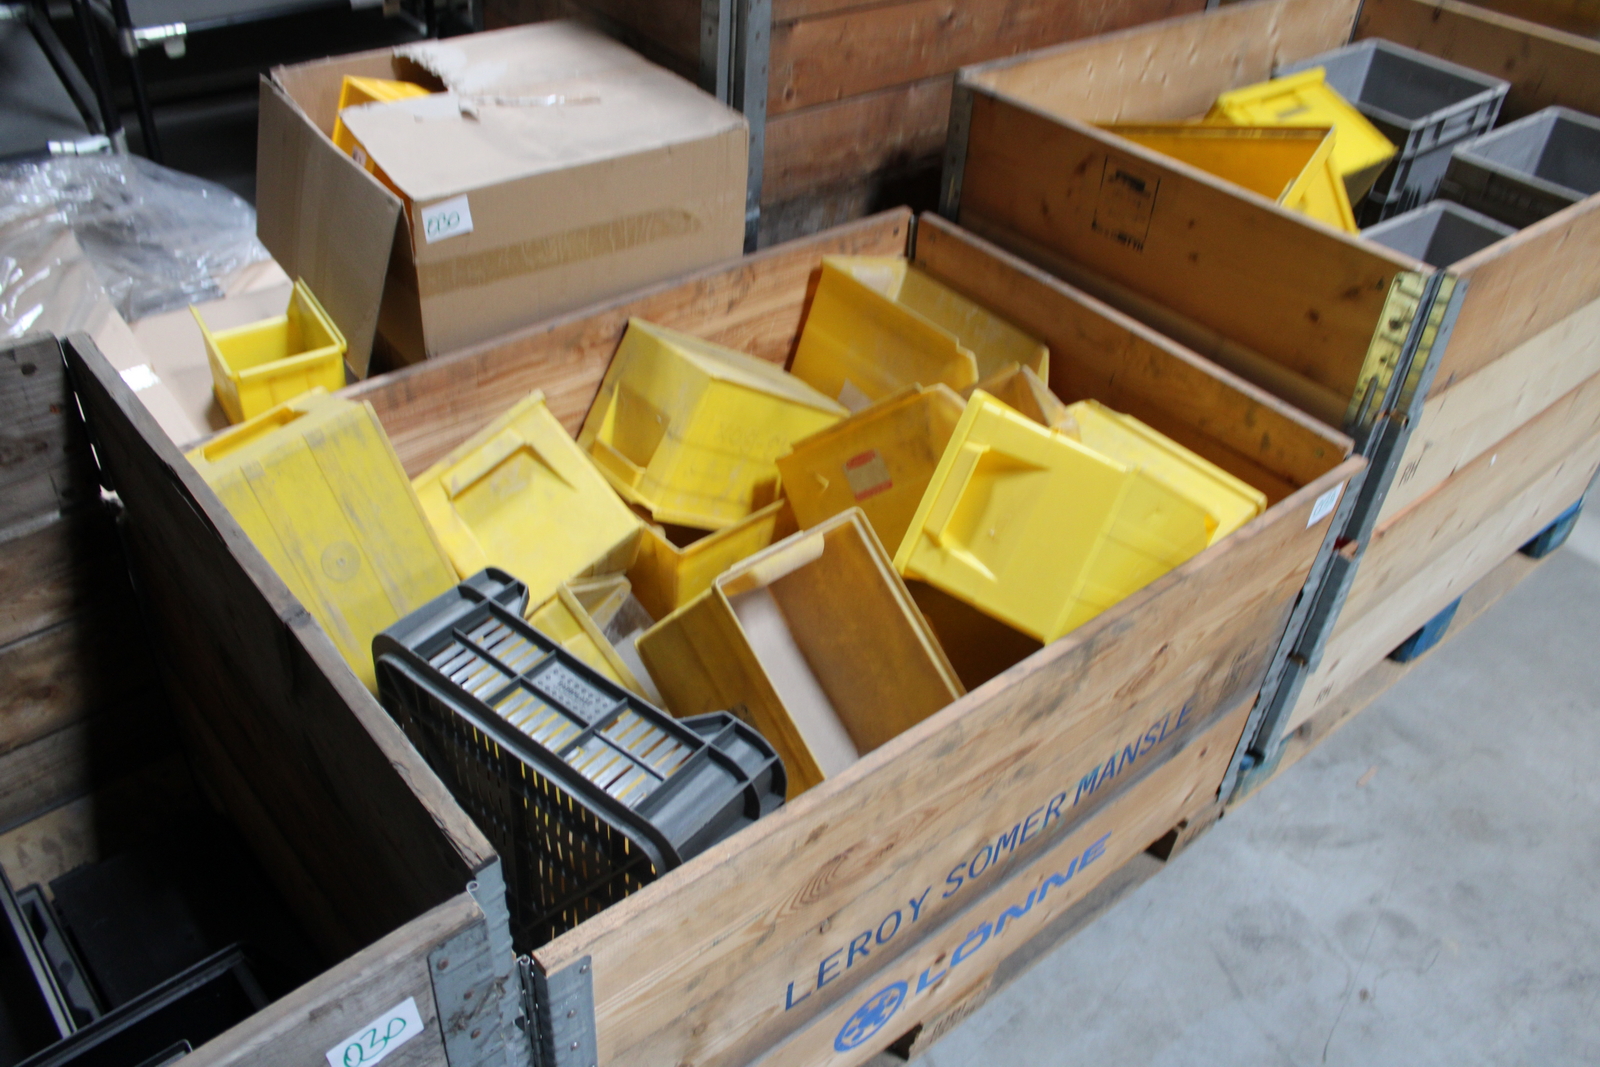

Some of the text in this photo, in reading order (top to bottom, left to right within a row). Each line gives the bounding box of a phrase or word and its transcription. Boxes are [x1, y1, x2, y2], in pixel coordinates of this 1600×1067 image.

[785, 694, 1197, 1011] LEROY SOMER MANSLE
[915, 830, 1112, 995] LÖNNE
